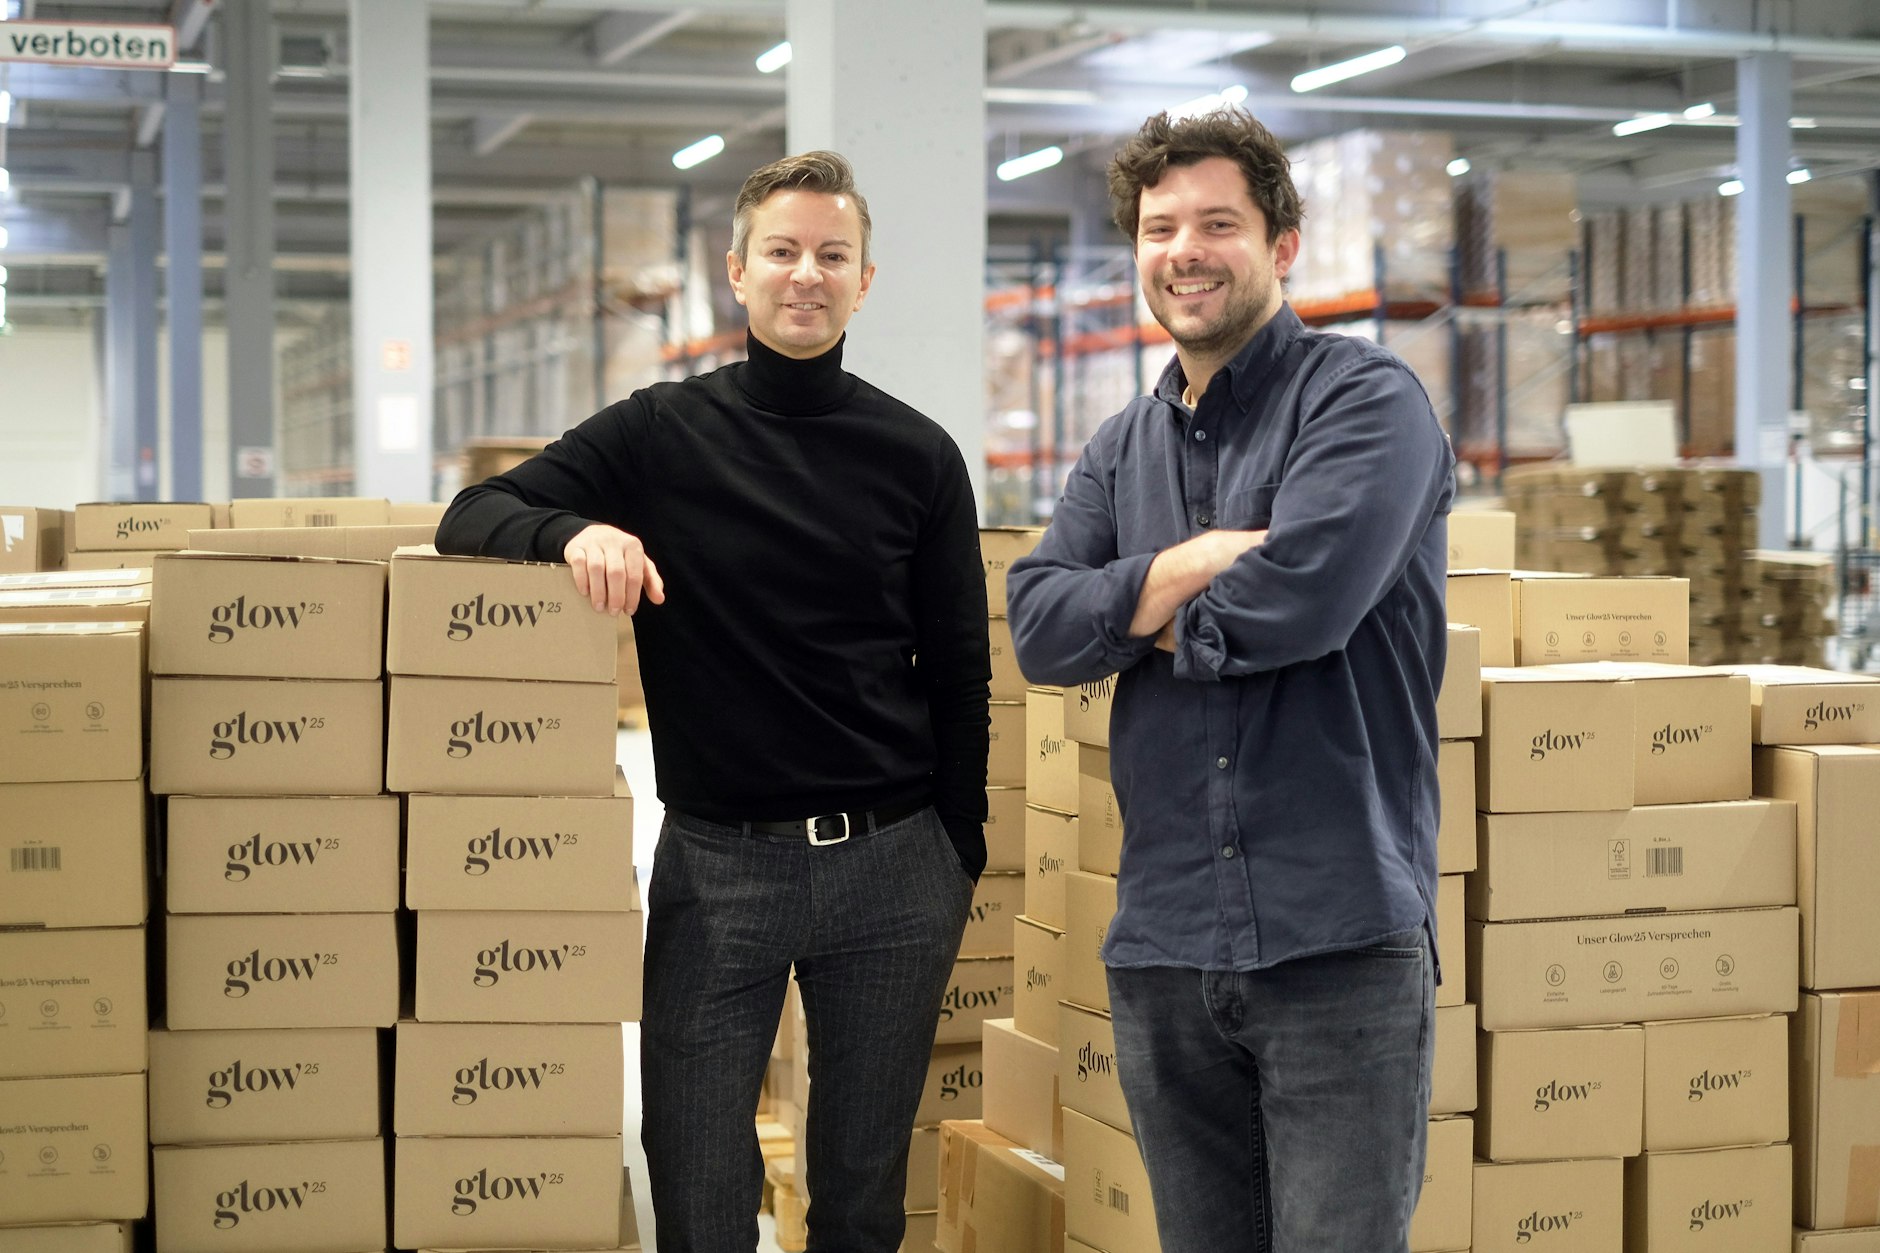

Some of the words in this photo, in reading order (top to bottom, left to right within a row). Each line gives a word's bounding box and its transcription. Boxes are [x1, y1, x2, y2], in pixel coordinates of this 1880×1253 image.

[11, 29, 168, 60] verboten
[1612, 613, 1652, 622] Versprechen
[20, 679, 82, 691] Versprechen
[1577, 934, 1608, 946] Unser
[1609, 931, 1647, 944] Glow25
[1648, 927, 1712, 943] Versprechen
[1663, 964, 1675, 973] 60
[30, 976, 90, 988] Versprechen
